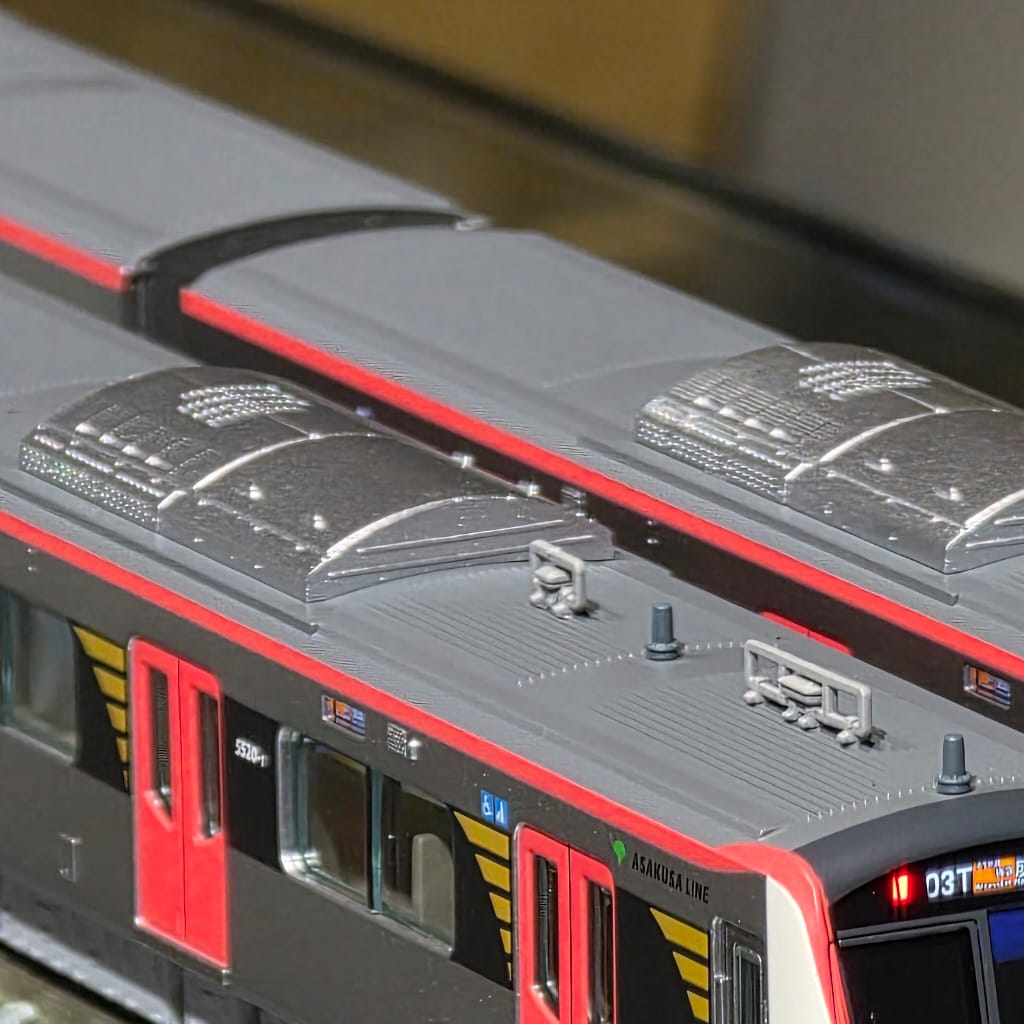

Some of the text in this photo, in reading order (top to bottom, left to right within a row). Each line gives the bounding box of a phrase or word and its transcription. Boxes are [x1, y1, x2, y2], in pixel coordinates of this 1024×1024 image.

[235, 738, 266, 767] 5520-1
[632, 852, 710, 904] ASAKUSA LINE
[926, 866, 972, 898] 03T
